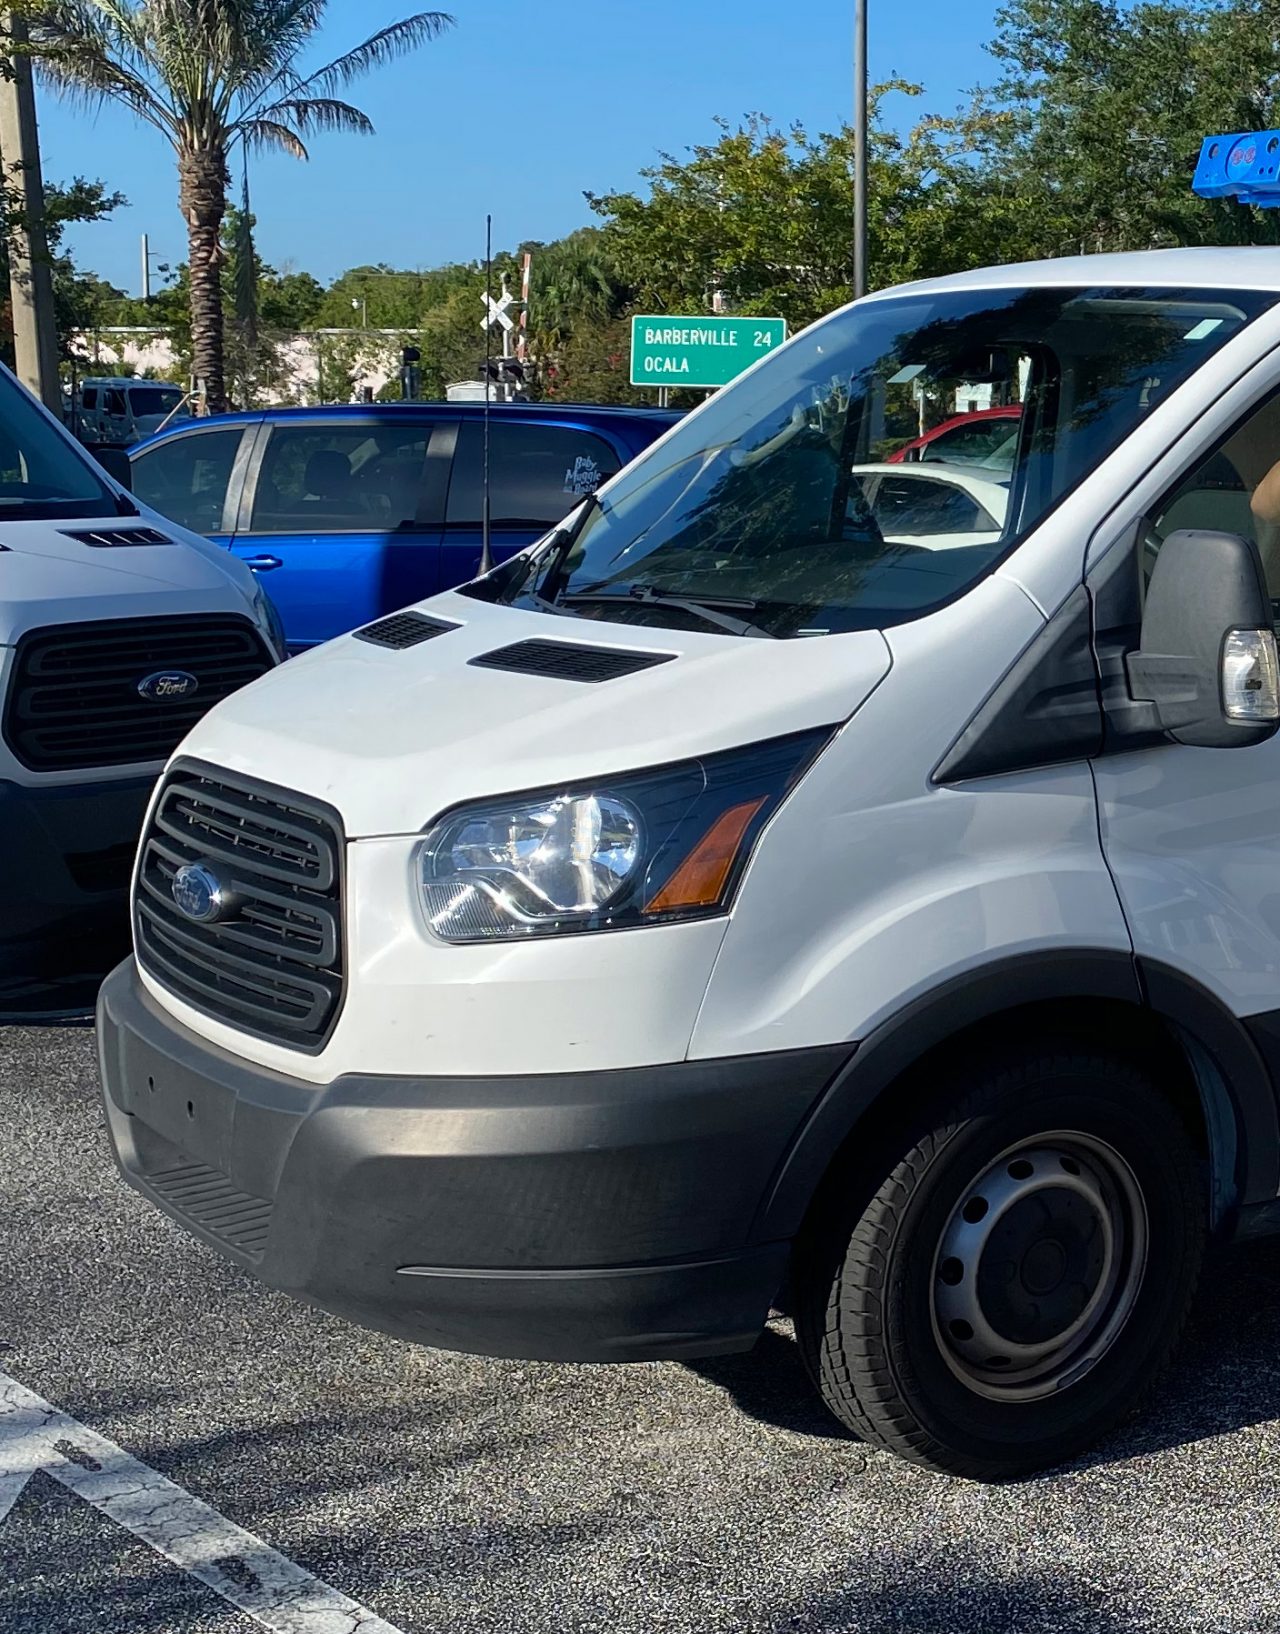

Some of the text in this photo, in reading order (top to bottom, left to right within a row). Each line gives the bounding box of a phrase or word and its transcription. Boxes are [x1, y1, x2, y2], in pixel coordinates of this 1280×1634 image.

[645, 329, 772, 347] BARBERVILLE 24
[644, 356, 689, 373] OCALA
[575, 456, 597, 471] Baby
[565, 469, 602, 485] Muggle
[156, 676, 188, 695] Ford
